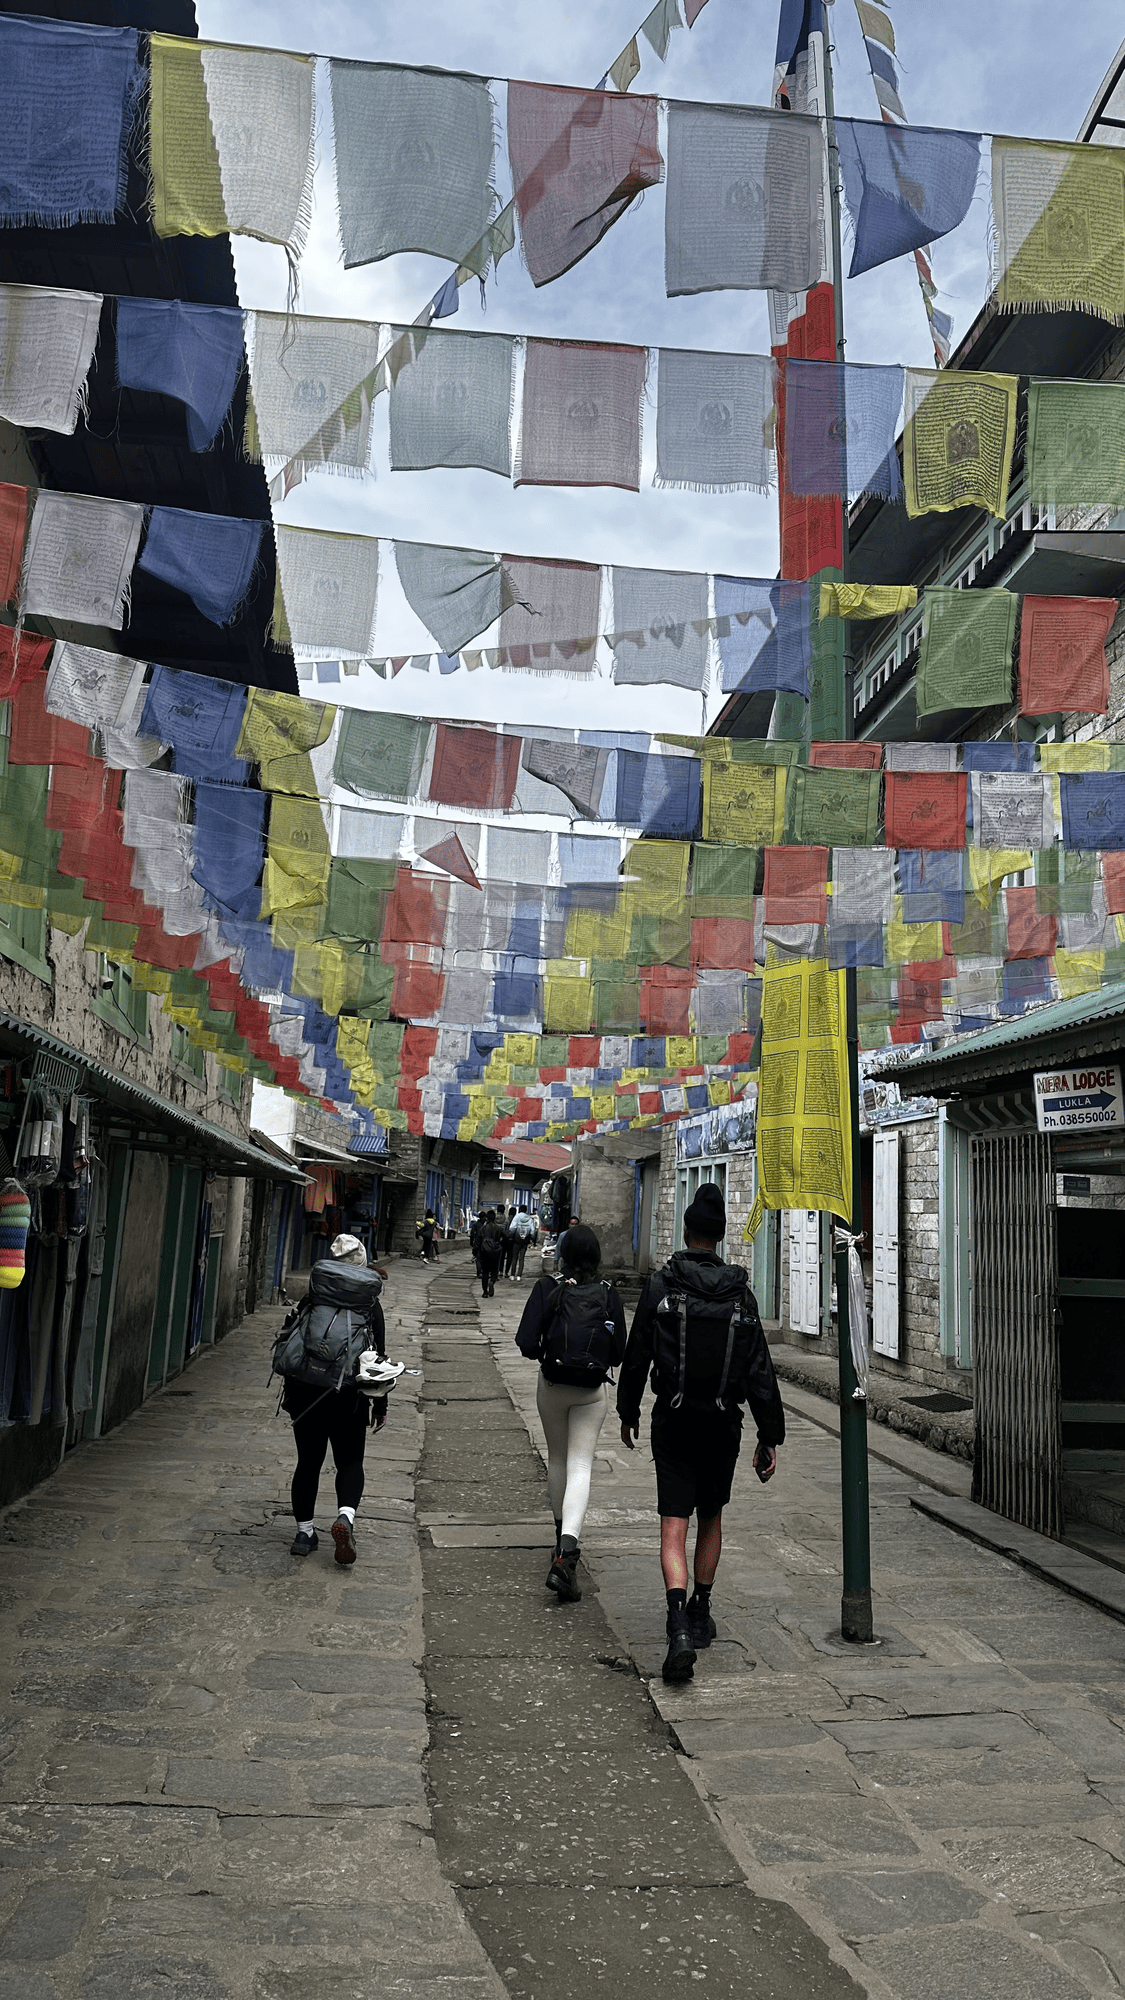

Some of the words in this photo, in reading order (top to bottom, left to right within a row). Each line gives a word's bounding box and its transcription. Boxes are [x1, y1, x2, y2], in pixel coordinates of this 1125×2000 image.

[1037, 1075, 1070, 1094] MERA
[1073, 1069, 1115, 1090] LODGE
[1059, 1098, 1091, 1108] LUKLA
